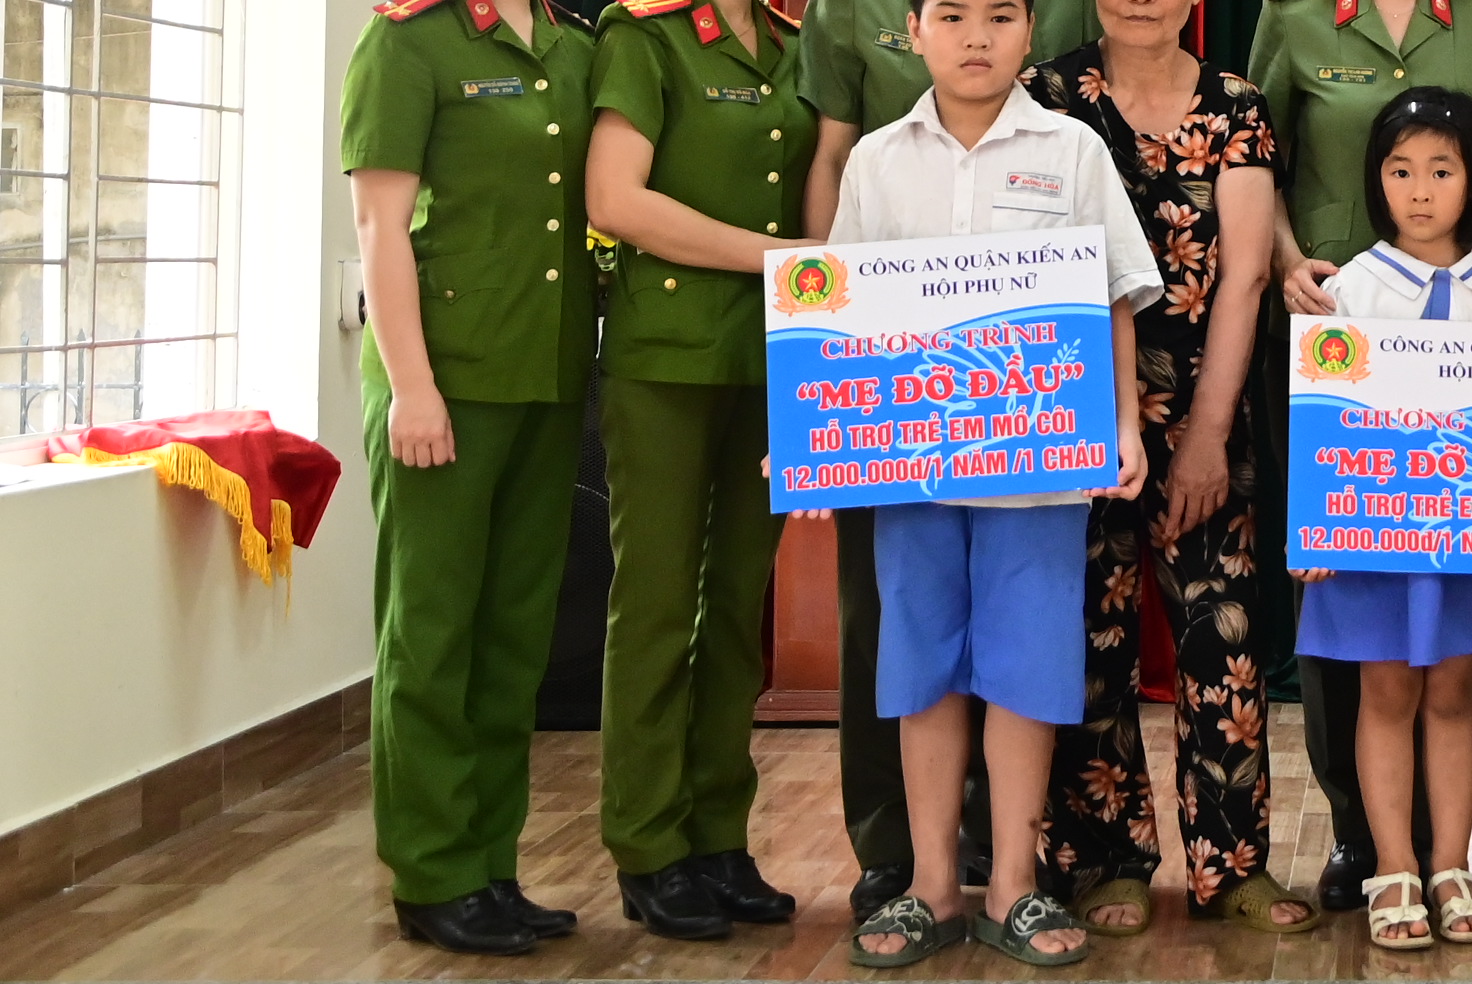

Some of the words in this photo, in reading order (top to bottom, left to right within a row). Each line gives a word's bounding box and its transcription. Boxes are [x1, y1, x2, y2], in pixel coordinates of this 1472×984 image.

[859, 258, 915, 276] CÔNG
[922, 257, 949, 272] AN
[954, 250, 1014, 271] QUẬN
[1017, 242, 1065, 265] KIẾN
[1070, 245, 1097, 261] AN
[922, 278, 962, 299] HỘI
[964, 277, 1004, 294] PHỤ
[1010, 272, 1038, 290] NỮ
[821, 330, 952, 360] CHƯƠNG
[959, 321, 1057, 348] TRÌNH
[1380, 335, 1433, 354] CÔNG
[1439, 340, 1465, 354] AN
[892, 364, 956, 404] ĐỠ
[1438, 361, 1472, 382] HỘI
[810, 419, 842, 452] HỖ
[849, 421, 893, 452] TRỢ
[899, 413, 941, 445] TRẺ
[949, 416, 985, 441] EM
[992, 406, 1029, 438] MỒ
[1036, 405, 1076, 434] CÔI
[1340, 407, 1465, 432] CHƯƠNG
[952, 449, 1007, 477] NĂM
[1012, 449, 1033, 474] /1
[1043, 440, 1106, 470] CHÁU
[1407, 444, 1466, 479] ĐỠ
[1326, 486, 1357, 516] HỖ
[1364, 492, 1406, 522] TRỢ
[1412, 488, 1452, 518] TRẺ
